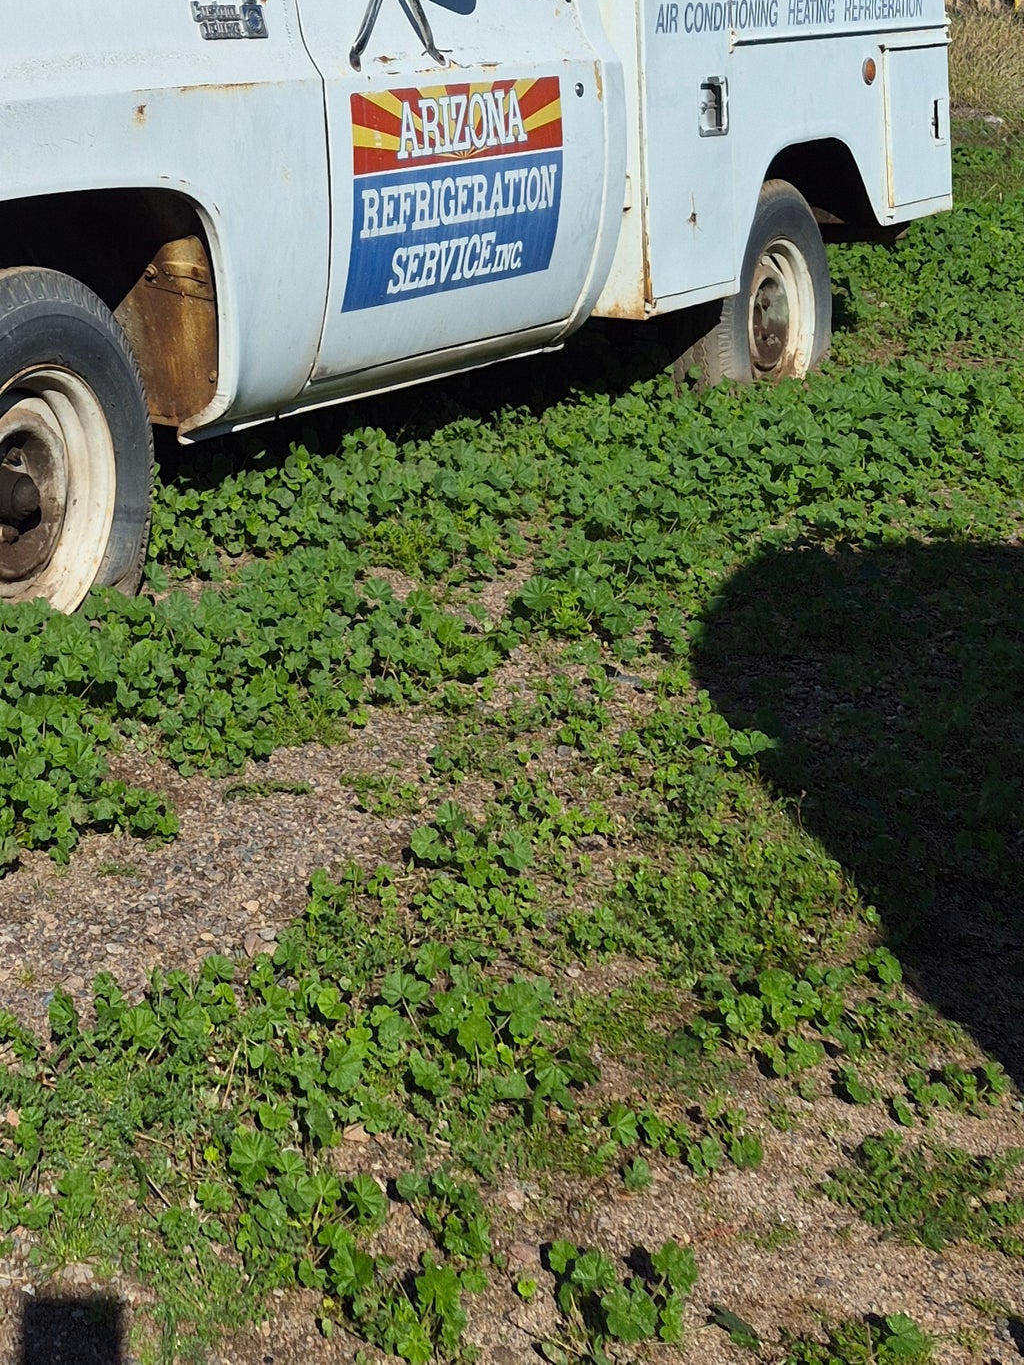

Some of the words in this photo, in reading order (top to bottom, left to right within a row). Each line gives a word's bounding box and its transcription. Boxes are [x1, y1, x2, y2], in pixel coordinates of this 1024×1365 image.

[655, 2, 678, 34] AIR
[398, 88, 528, 160] ARIZONA
[359, 164, 558, 239] REFRIGERATION
[386, 231, 497, 295] SERVICE
